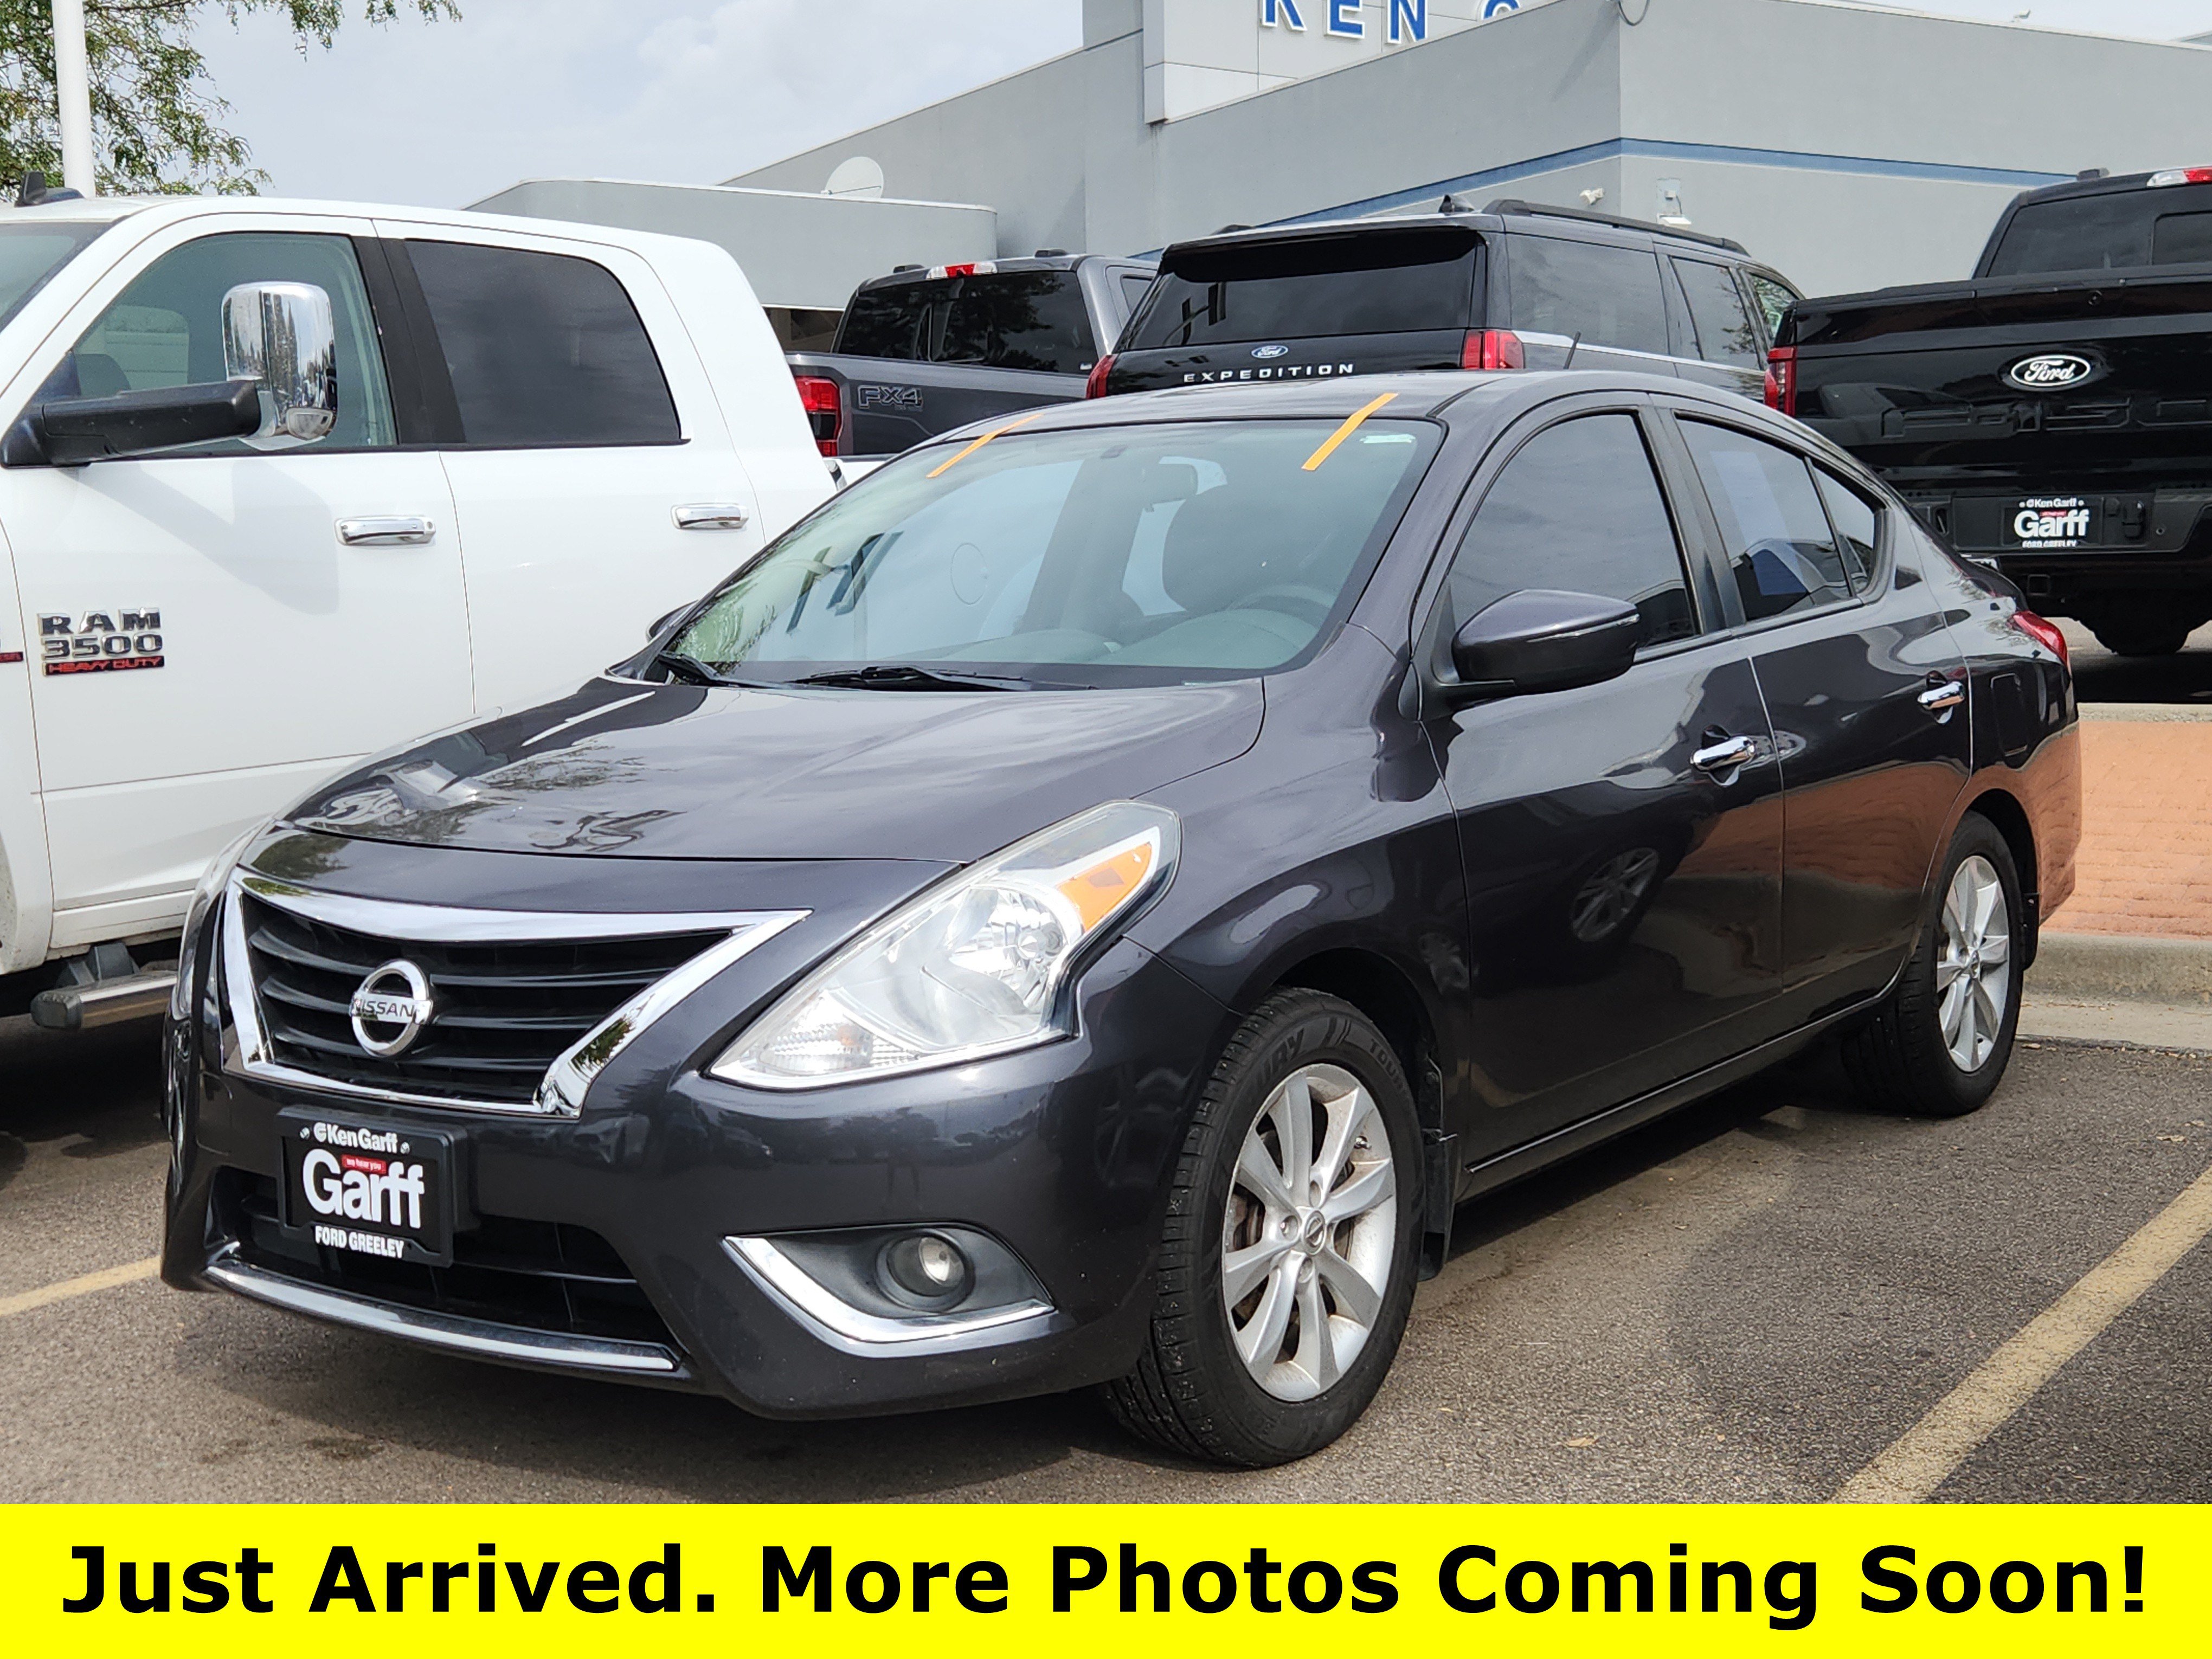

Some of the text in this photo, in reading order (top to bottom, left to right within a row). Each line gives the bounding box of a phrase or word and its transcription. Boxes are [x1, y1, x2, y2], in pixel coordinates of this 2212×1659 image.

[1257, 345, 1283, 358] Ford
[1183, 363, 1354, 383] EXPEDITION
[2024, 359, 2076, 382] Ford
[857, 384, 924, 409] FX4
[2014, 509, 2089, 538] Garff
[37, 607, 161, 636] RAM
[41, 631, 163, 660] 3500
[49, 655, 162, 673] HEAVY DUTY
[353, 998, 415, 1017] NISSAN
[303, 1148, 425, 1229] Garff
[315, 1225, 404, 1259] FORD GREELEY
